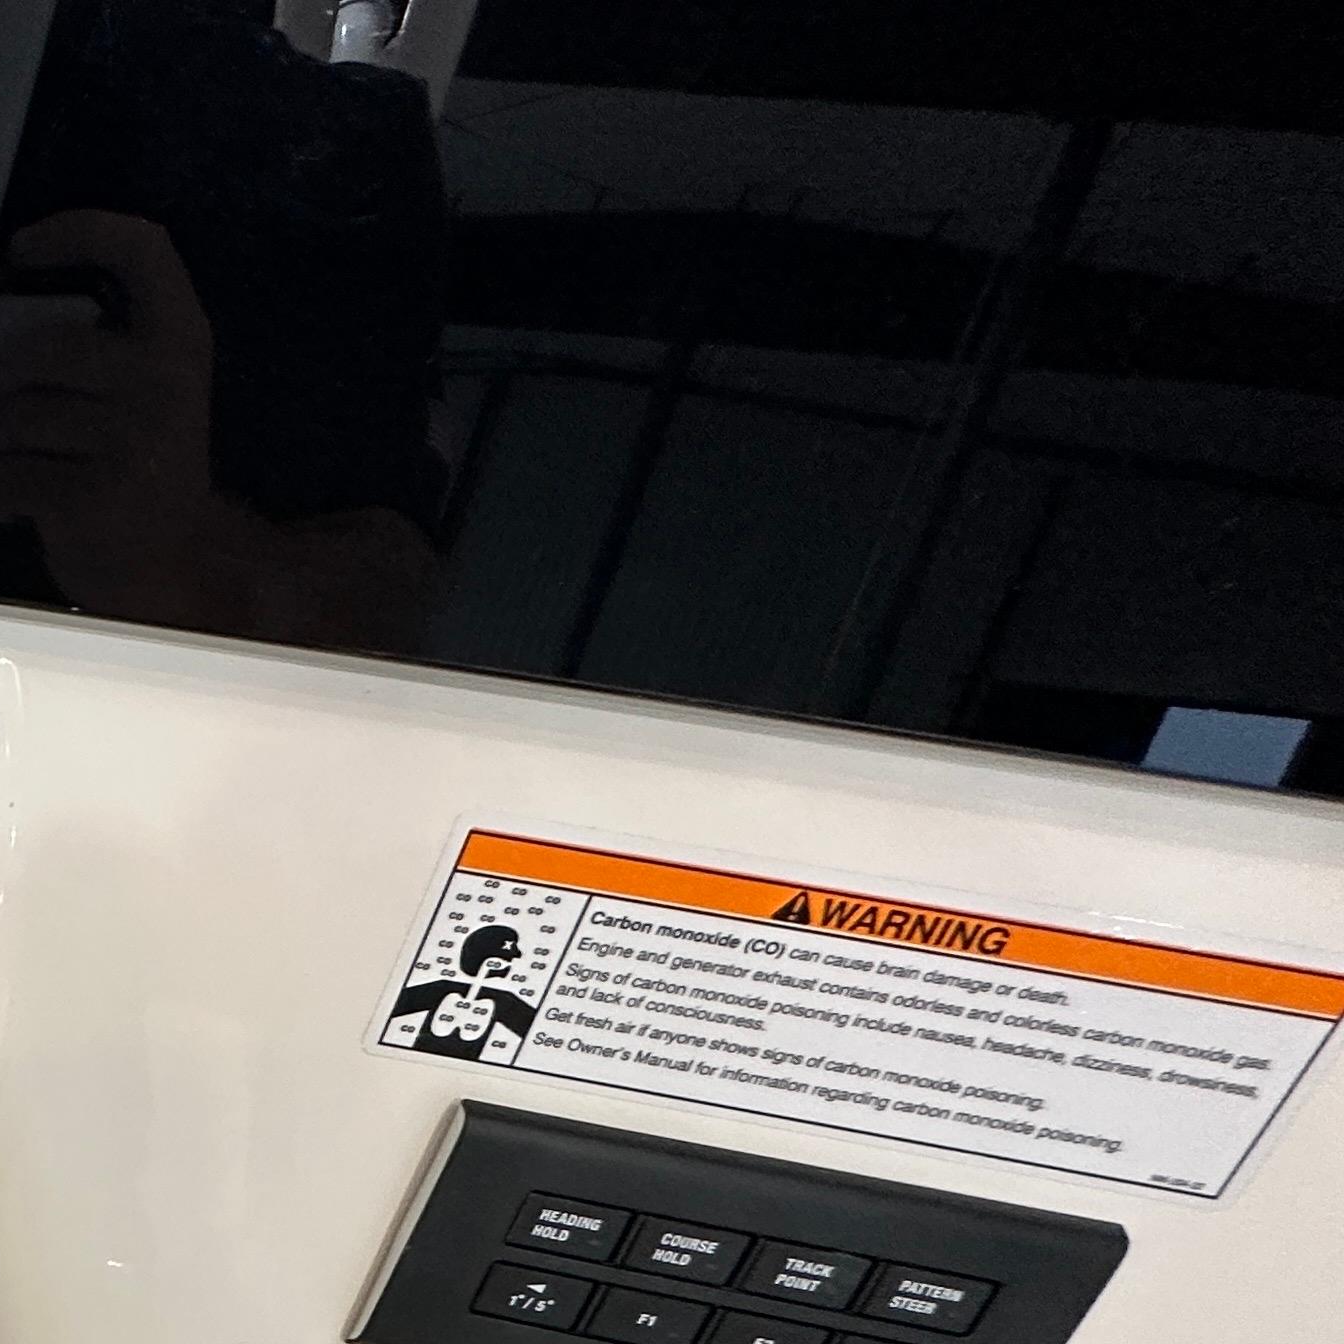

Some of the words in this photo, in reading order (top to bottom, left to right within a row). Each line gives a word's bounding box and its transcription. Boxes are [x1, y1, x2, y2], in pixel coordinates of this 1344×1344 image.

[820, 898, 1011, 956] WARNING
[590, 911, 654, 935] Carbon
[655, 925, 742, 949] monoxide
[743, 938, 786, 960] (CO)
[788, 948, 821, 963] can
[822, 954, 875, 972] cause
[875, 960, 921, 980] brain
[922, 970, 993, 994] damage
[994, 984, 1017, 996] or
[1017, 987, 1069, 1007] death.
[539, 1209, 603, 1231] HEADING
[531, 1224, 570, 1242] HOLD
[660, 1233, 719, 1254] COURSE
[651, 1248, 692, 1266] HOLD
[785, 1258, 835, 1278] TRACK
[774, 1273, 822, 1292] POINT
[898, 1280, 965, 1302] PATTERN
[889, 1295, 937, 1315] STEER
[637, 1313, 657, 1327] F1
